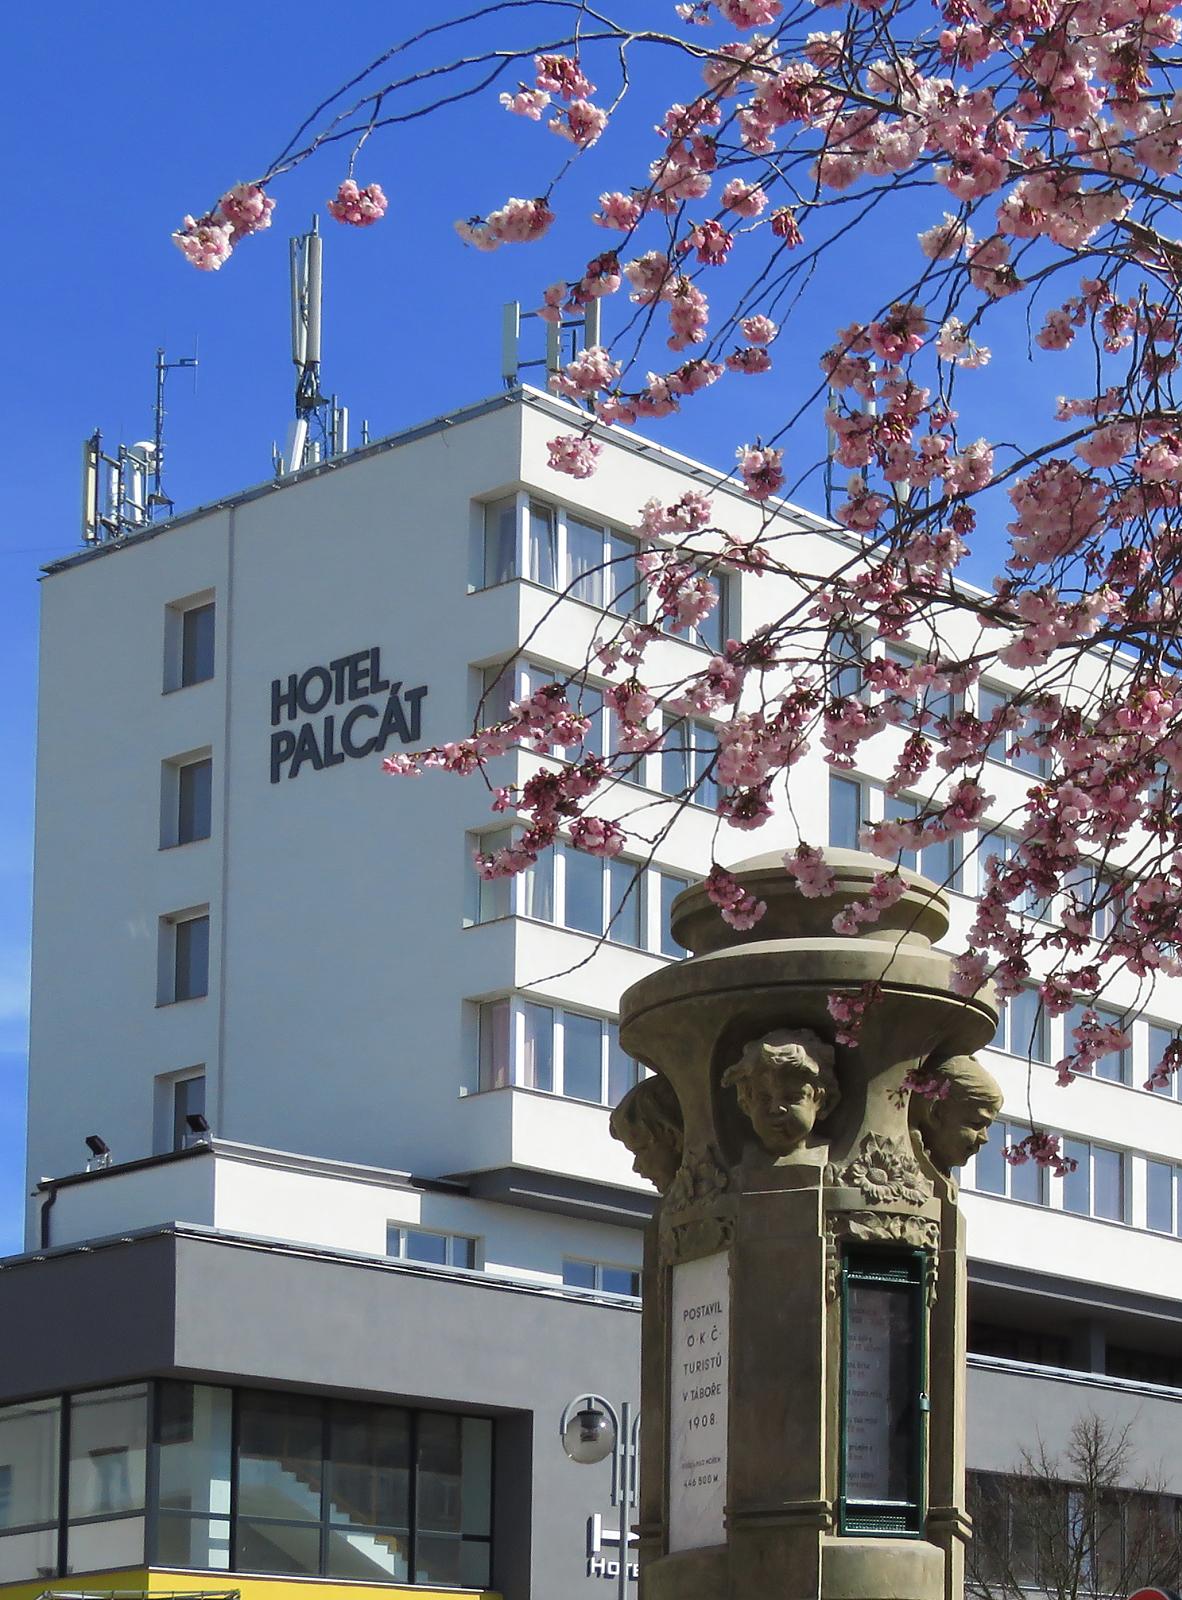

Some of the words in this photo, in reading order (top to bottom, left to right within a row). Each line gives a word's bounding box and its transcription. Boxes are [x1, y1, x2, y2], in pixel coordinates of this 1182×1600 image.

[271, 647, 389, 726] HOTEL
[270, 682, 428, 784] PALCÁT
[683, 1302, 723, 1322] POSTAVIL
[682, 1391, 689, 1403] V
[691, 1382, 722, 1401] TÁBOŘE
